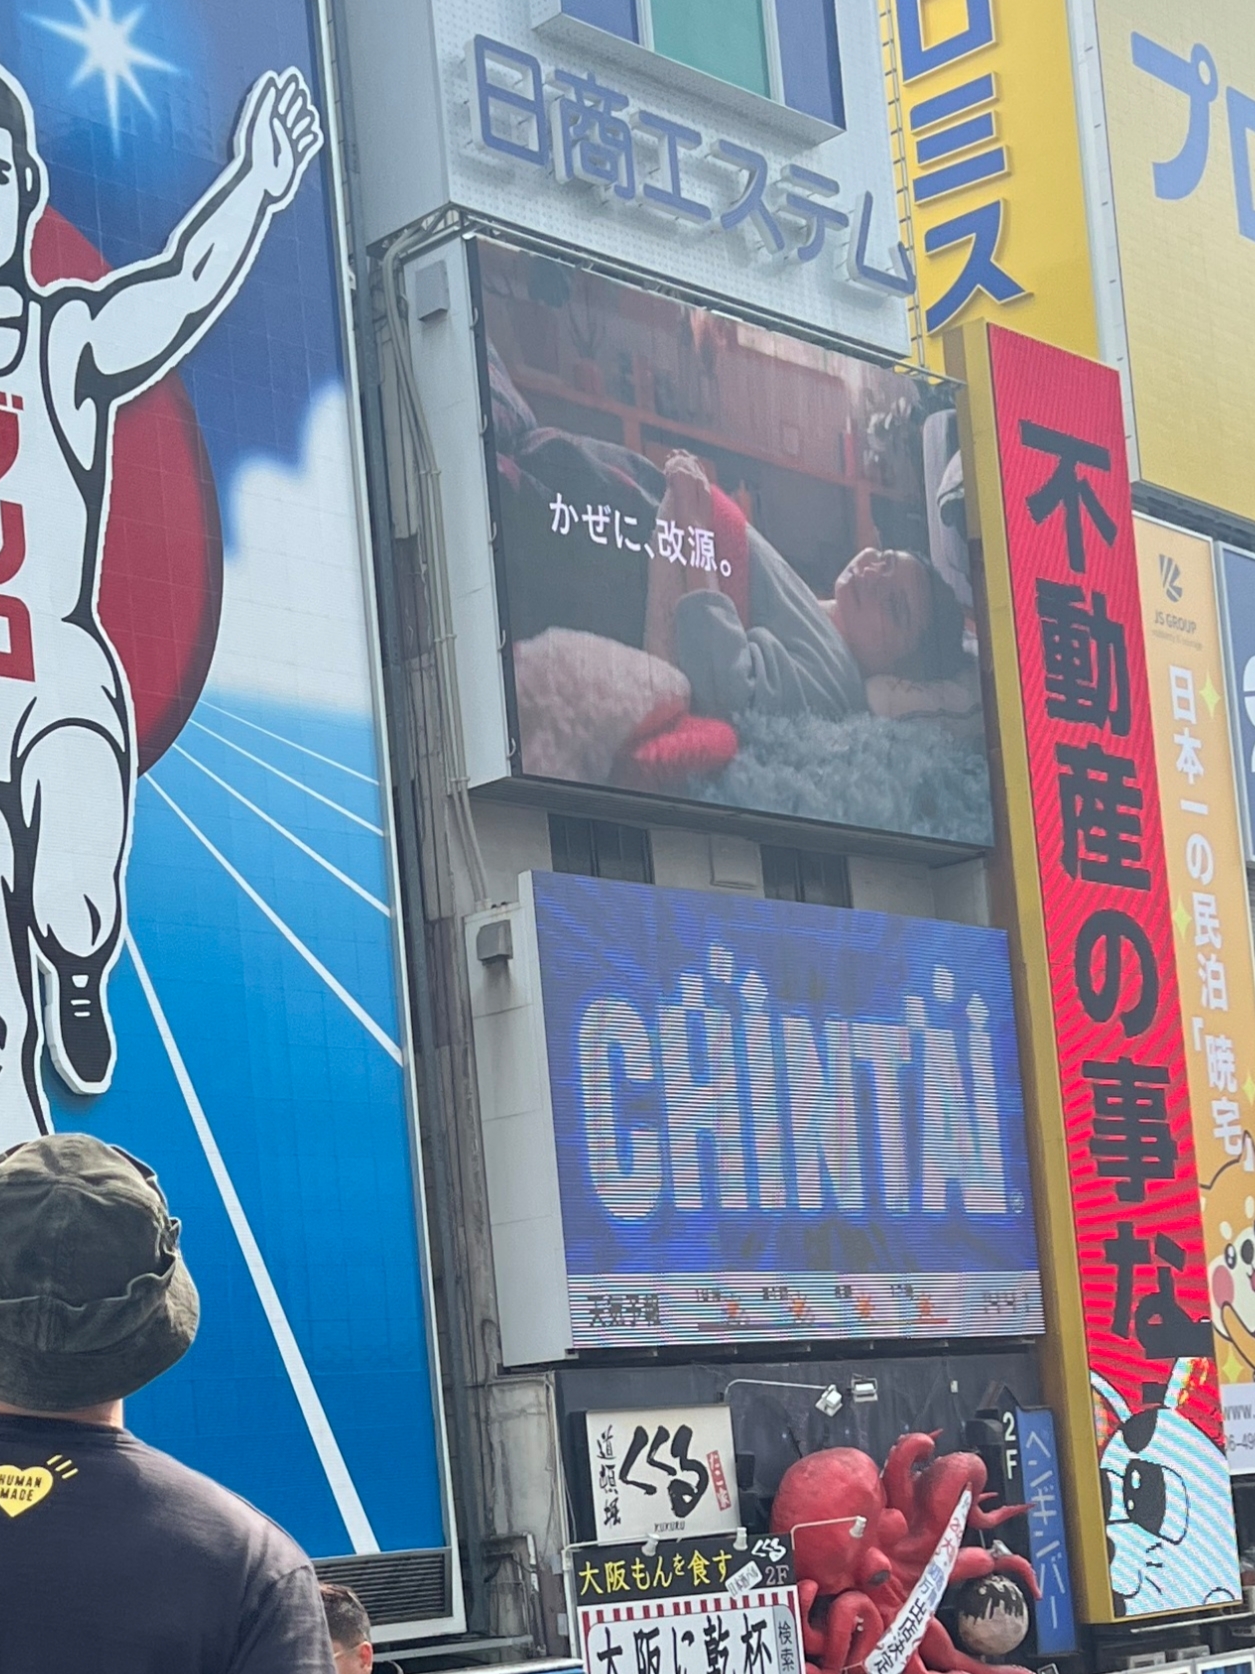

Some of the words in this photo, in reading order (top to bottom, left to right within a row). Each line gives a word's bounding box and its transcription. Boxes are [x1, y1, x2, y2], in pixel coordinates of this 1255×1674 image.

[473, 32, 916, 298] 日商エステム
[549, 492, 733, 577] かぜに、改源。
[619, 1424, 709, 1518] くくる
[1002, 1411, 1018, 1480] 2F
[0, 1488, 34, 1501] MADE
[654, 1521, 686, 1533] KUKURU
[578, 1550, 733, 1596] 大阪もんを食す
[764, 1564, 790, 1586] 2F
[777, 1620, 796, 1673] 検索
